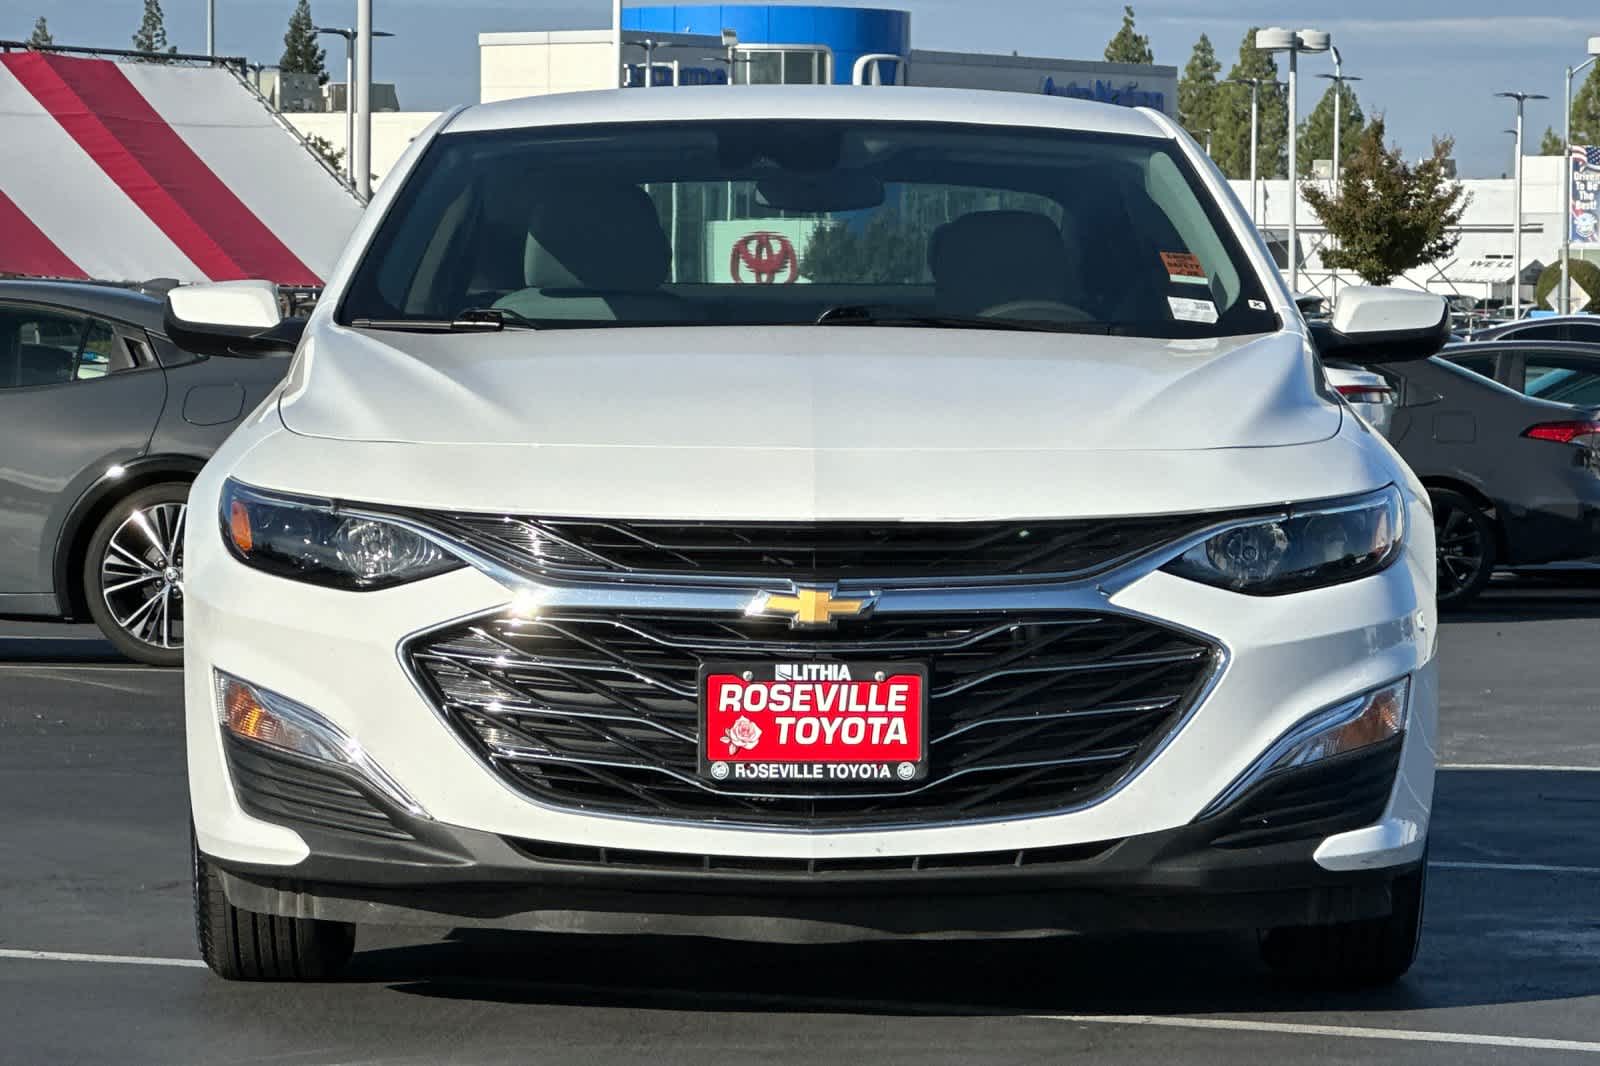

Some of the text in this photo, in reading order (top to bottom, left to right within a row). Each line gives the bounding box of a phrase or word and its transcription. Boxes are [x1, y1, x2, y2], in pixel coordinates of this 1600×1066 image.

[792, 665, 851, 681] LITHIA
[719, 684, 908, 712] ROSEVILLE
[775, 717, 908, 745] TOYOTA
[735, 764, 891, 779] ROSEVILLE TOYOTA
